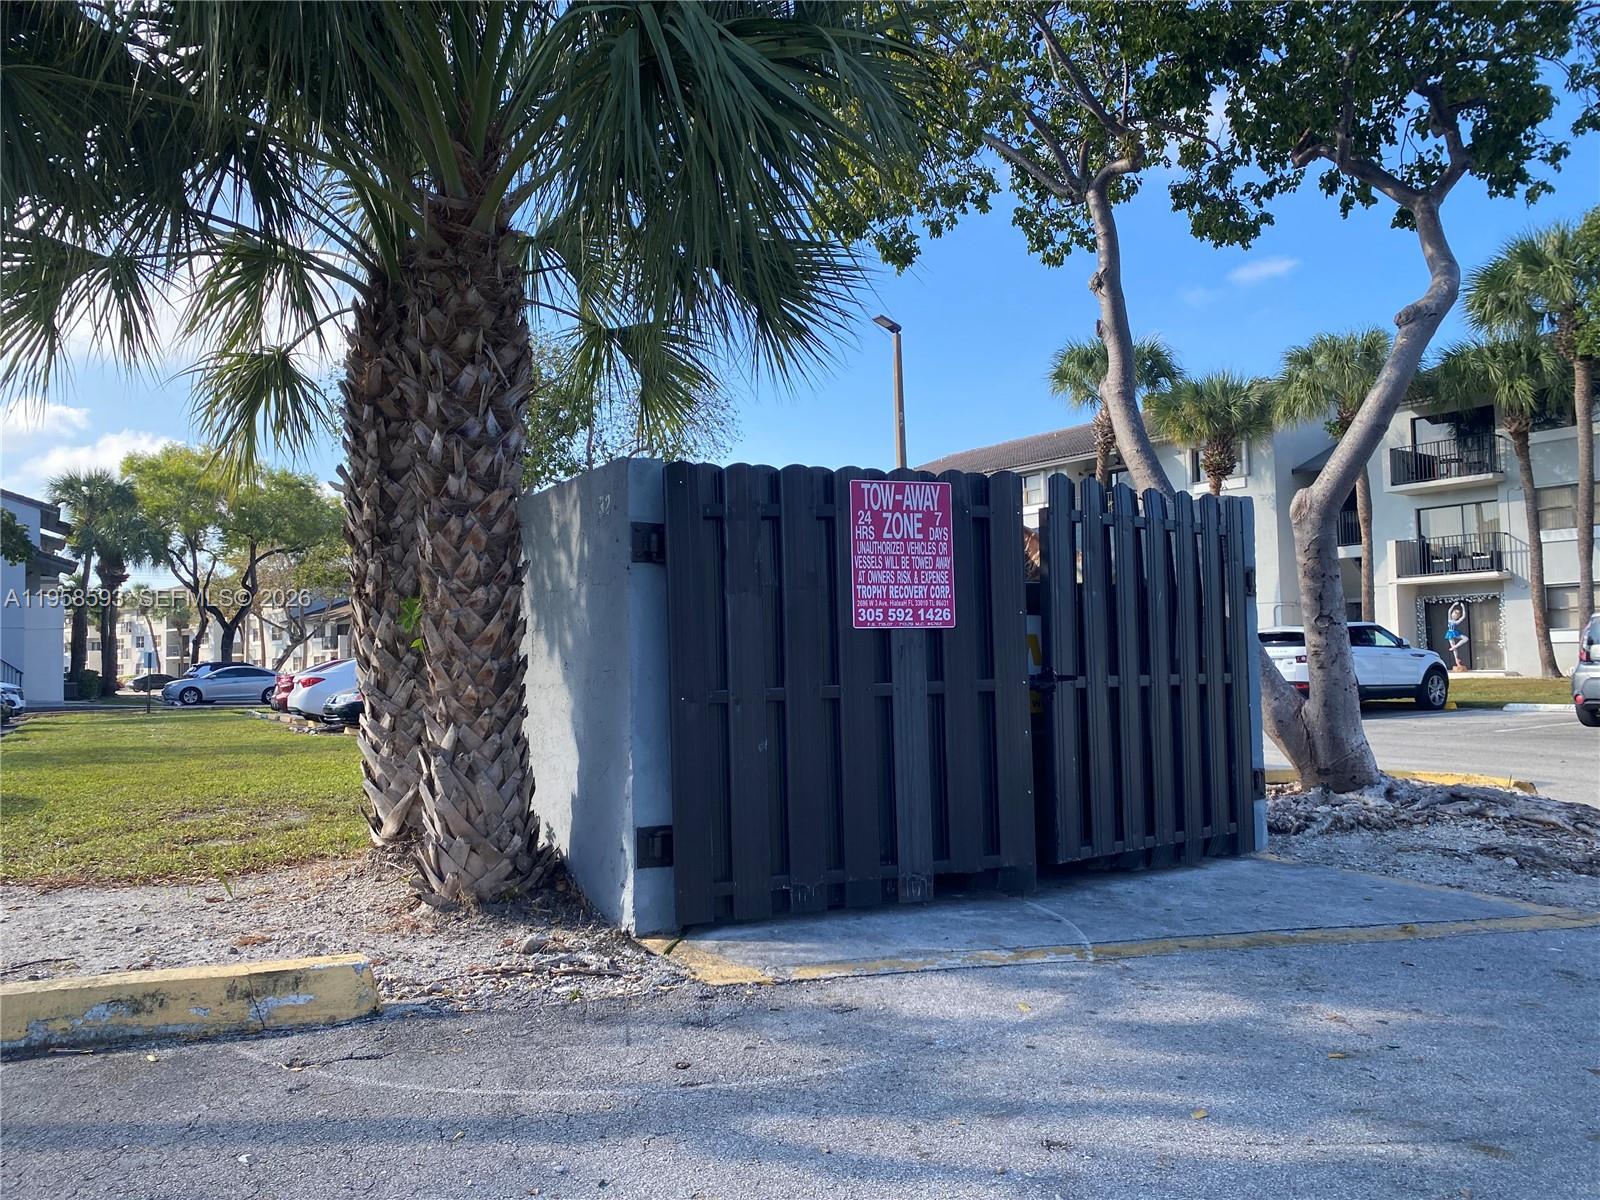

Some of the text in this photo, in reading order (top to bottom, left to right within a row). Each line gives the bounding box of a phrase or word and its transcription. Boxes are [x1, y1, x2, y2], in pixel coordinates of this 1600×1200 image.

[861, 483, 940, 511] TOW-AWAY
[858, 510, 872, 525] 24
[934, 512, 943, 526] 7
[882, 512, 923, 539] ZONE
[855, 526, 875, 540] HRS
[929, 527, 948, 541] DAYS
[856, 541, 948, 555] UNAUTHORIZED VEHICLES OR
[854, 556, 951, 570] VESSELS WILL BE TOWED AWAY
[857, 570, 949, 584] AT OWNERS RISK & EXPENSE
[856, 585, 951, 599] TROPHY RECOVERY CORP.
[858, 608, 951, 621] 305 592 1426
